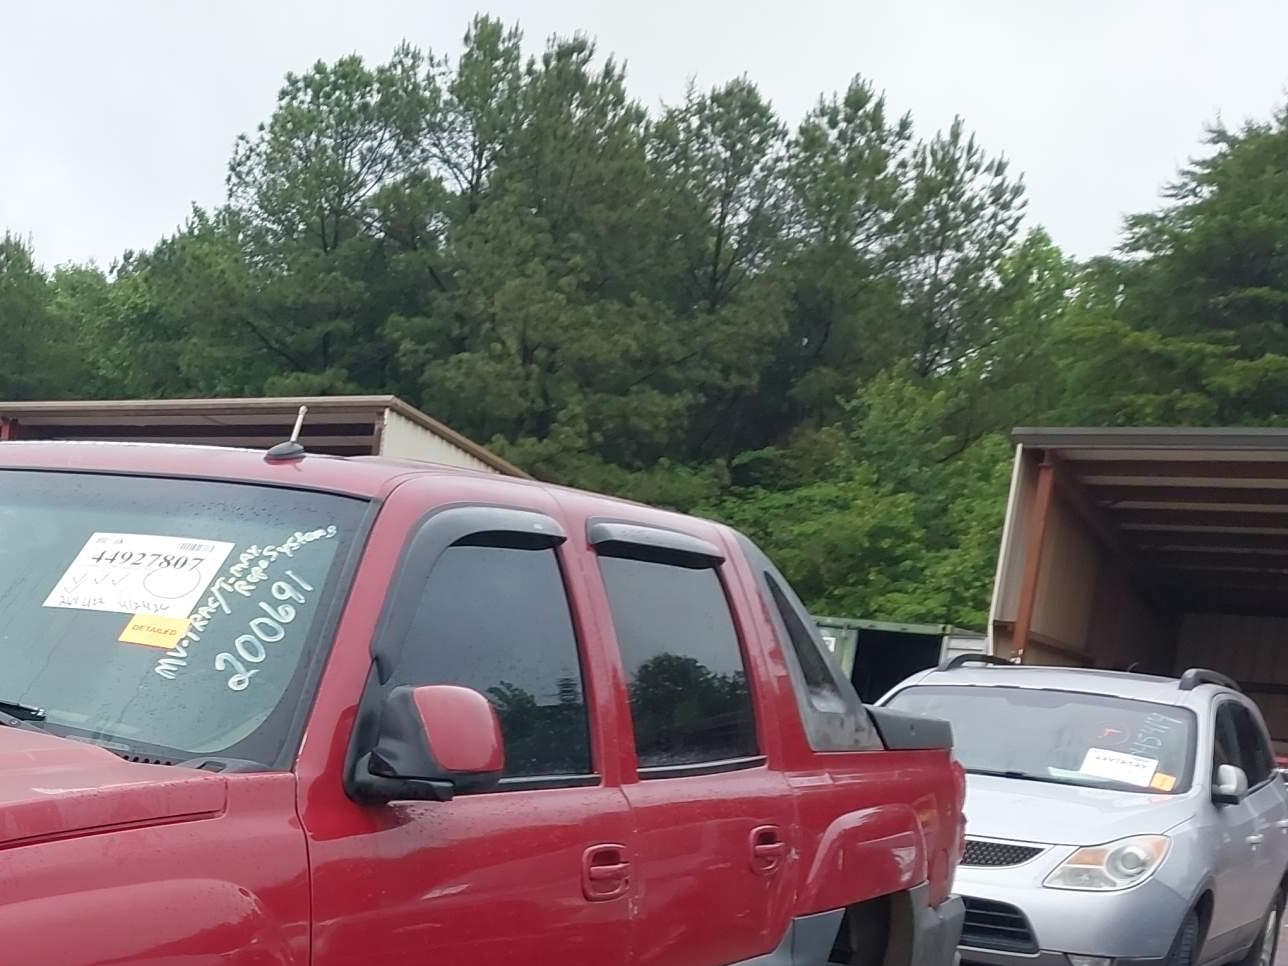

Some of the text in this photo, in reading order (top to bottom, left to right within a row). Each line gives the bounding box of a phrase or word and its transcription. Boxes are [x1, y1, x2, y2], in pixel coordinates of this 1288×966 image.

[91, 549, 206, 571] 44927807
[131, 624, 178, 637] DETAILED
[215, 570, 313, 691] 200691
